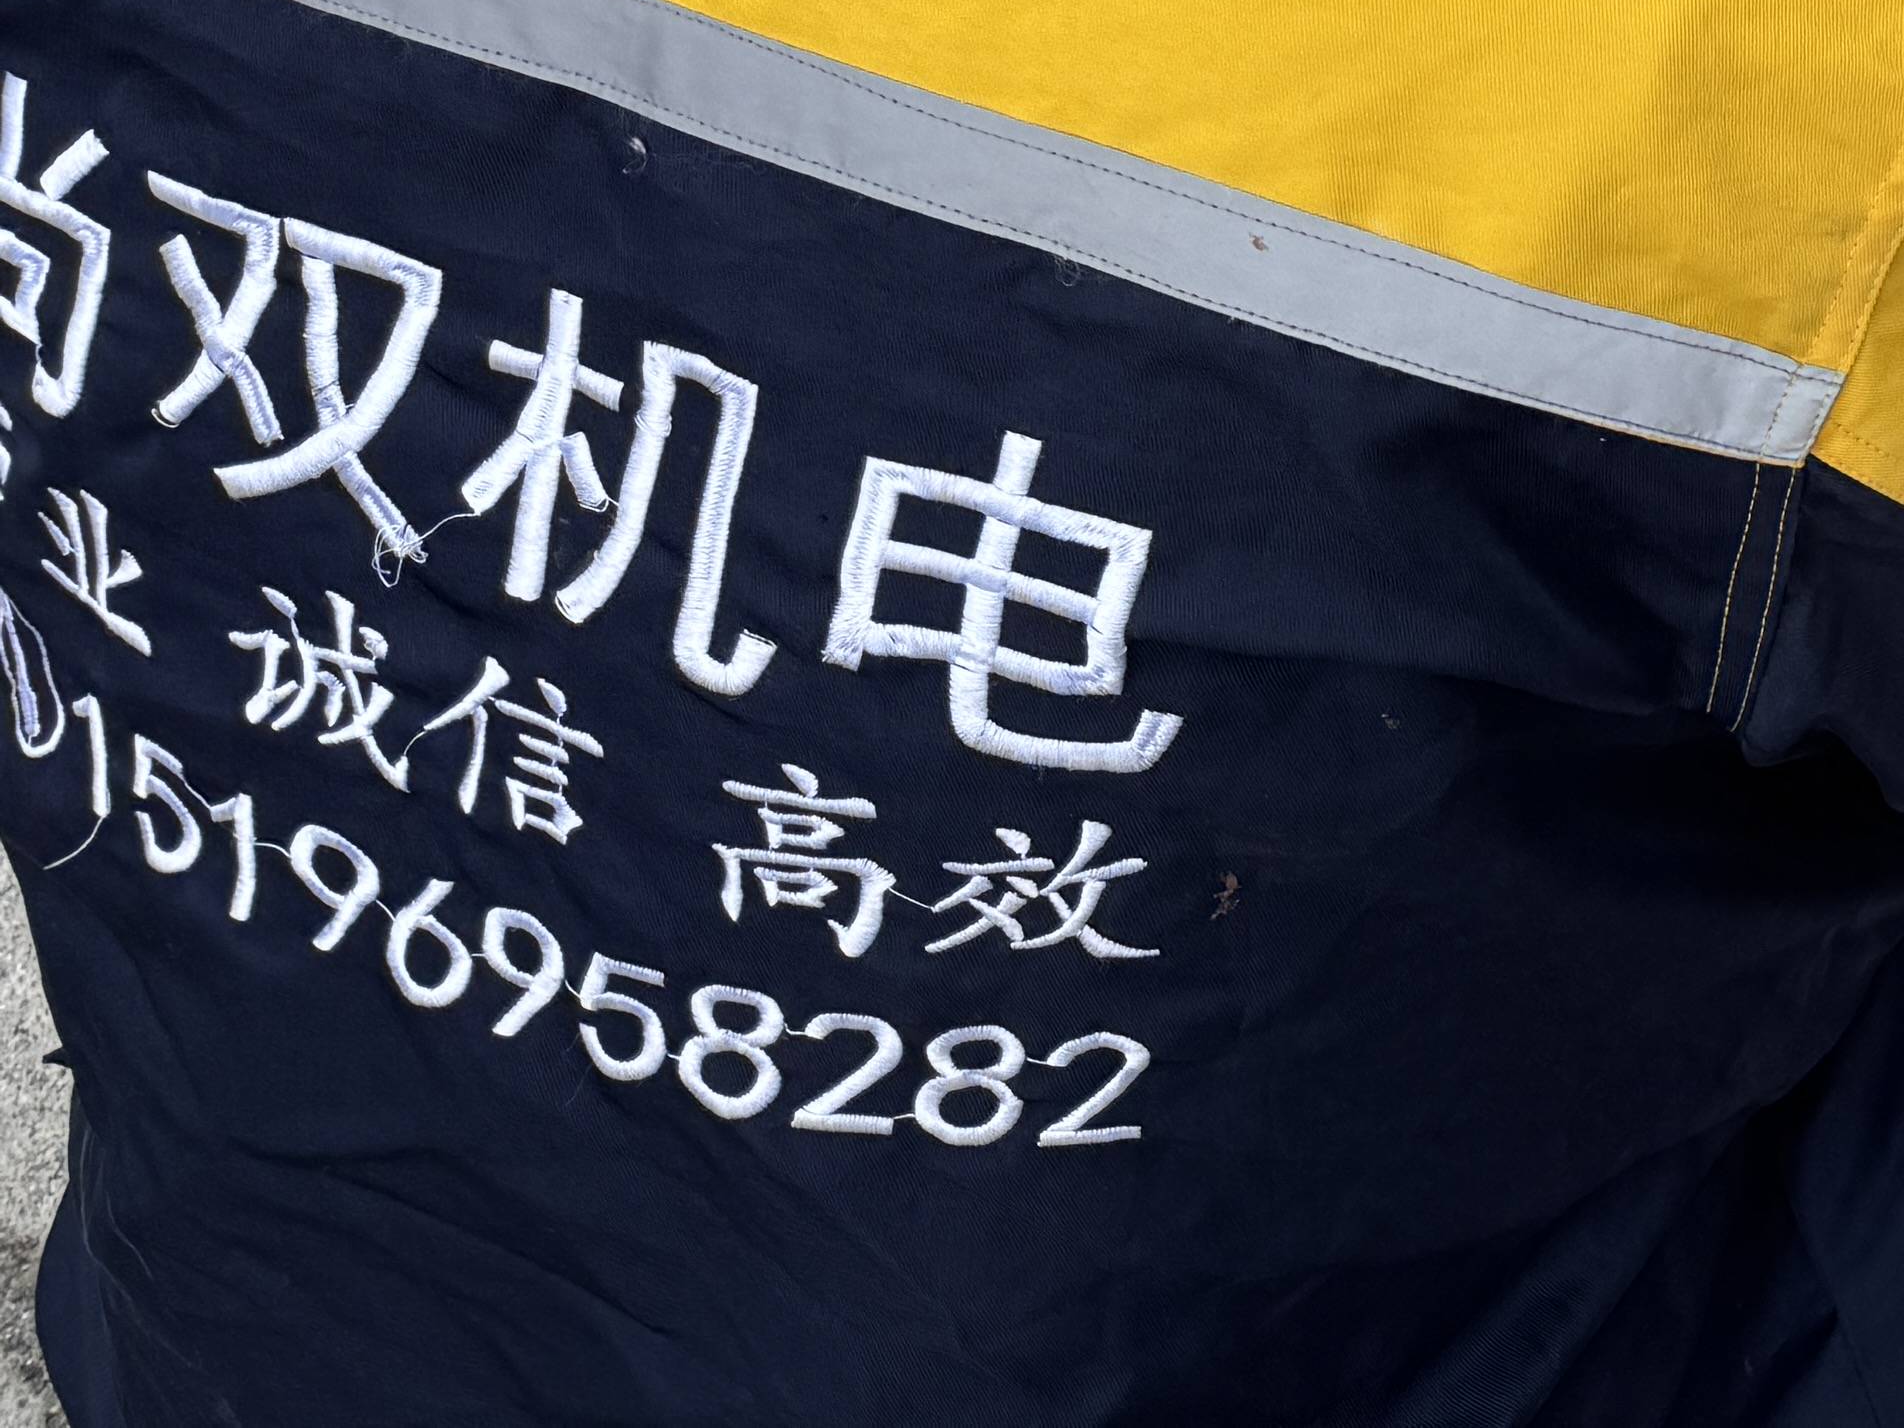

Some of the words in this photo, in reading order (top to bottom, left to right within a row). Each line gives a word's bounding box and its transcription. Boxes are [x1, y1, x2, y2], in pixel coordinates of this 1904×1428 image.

[73, 695, 1149, 1147] 15196958282
[229, 587, 603, 844] 诚信
[712, 764, 1159, 957] 高效
